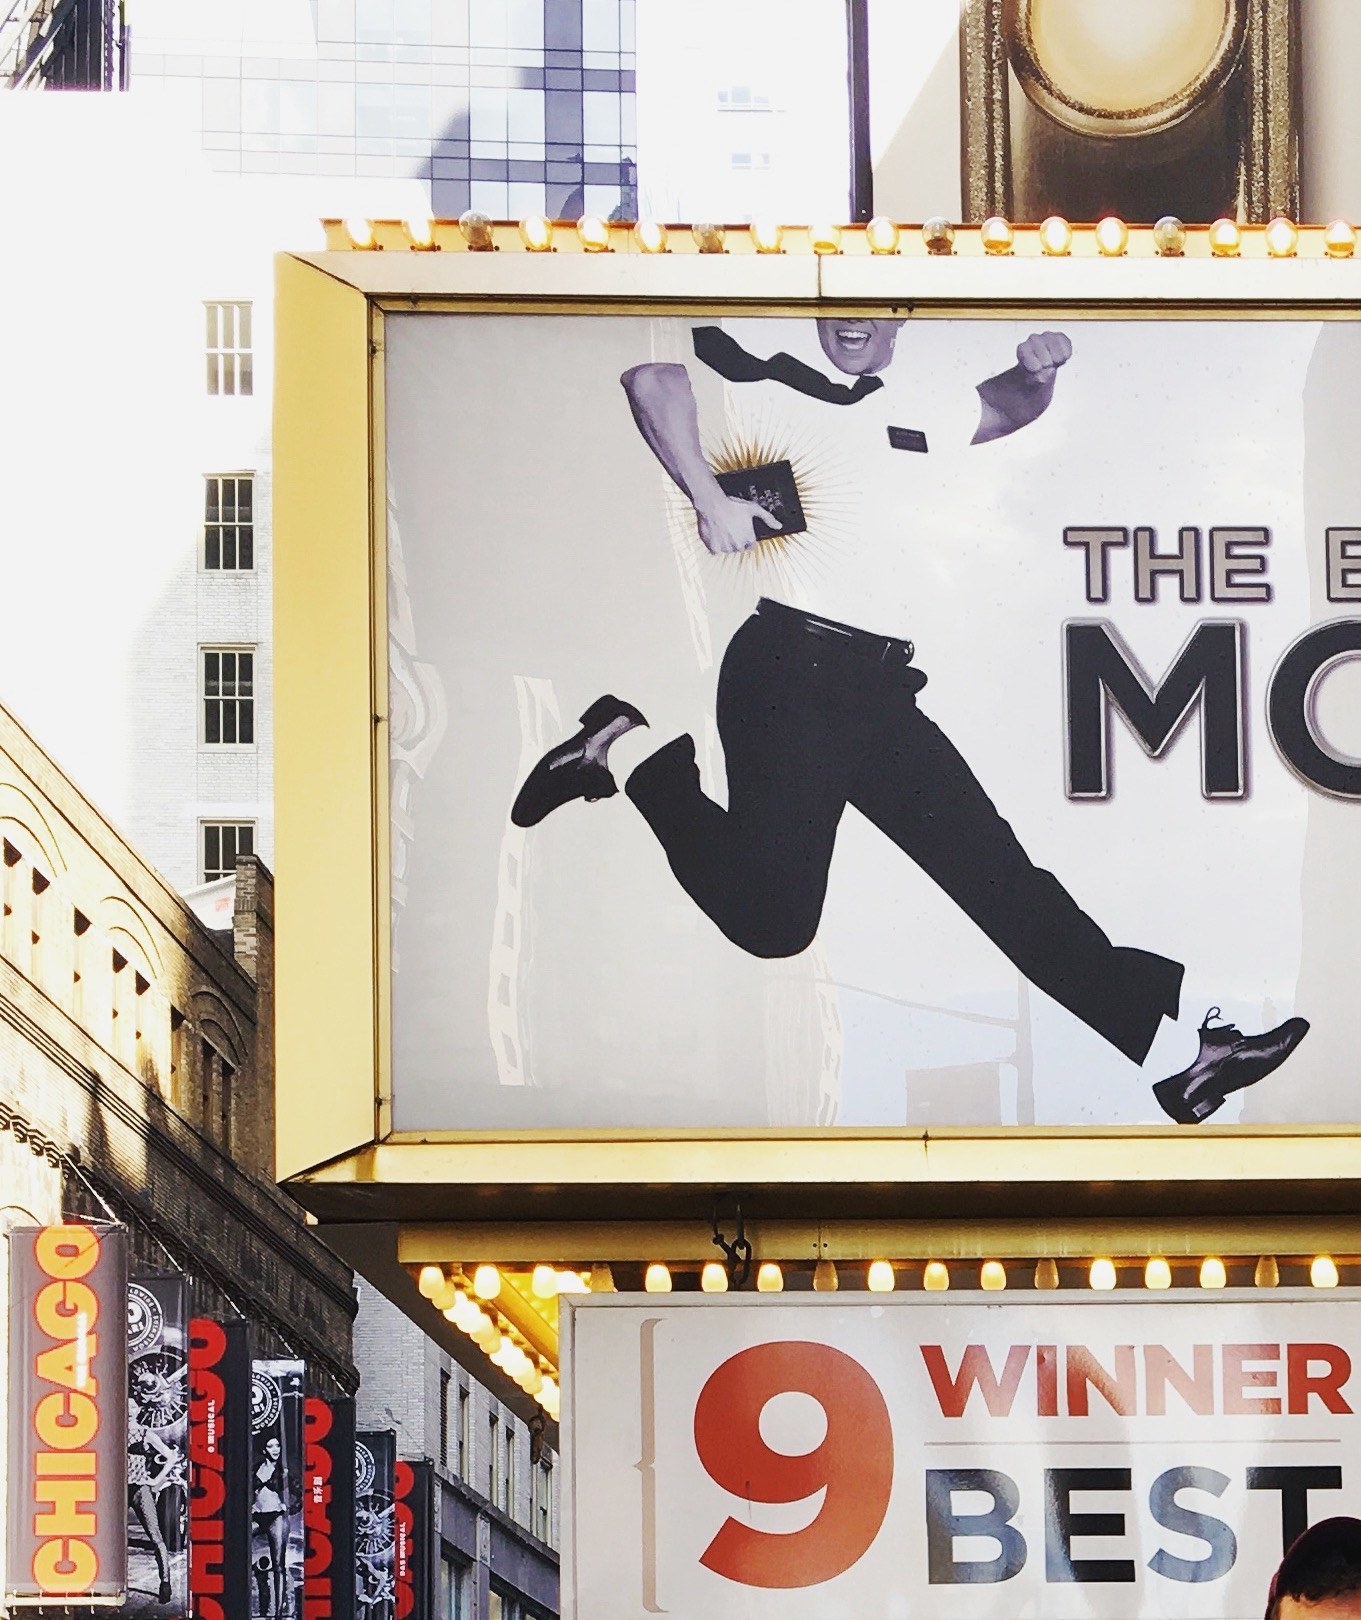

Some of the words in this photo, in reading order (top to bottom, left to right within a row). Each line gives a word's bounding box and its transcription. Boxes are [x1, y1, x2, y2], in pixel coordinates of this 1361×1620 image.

[1063, 527, 1271, 601] THE
[32, 1224, 101, 1595] CHICAGO
[207, 1400, 216, 1444] MUSICAL
[919, 1343, 1354, 1417] WINNER
[694, 1341, 894, 1588] 9
[925, 1465, 1342, 1584] BEST
